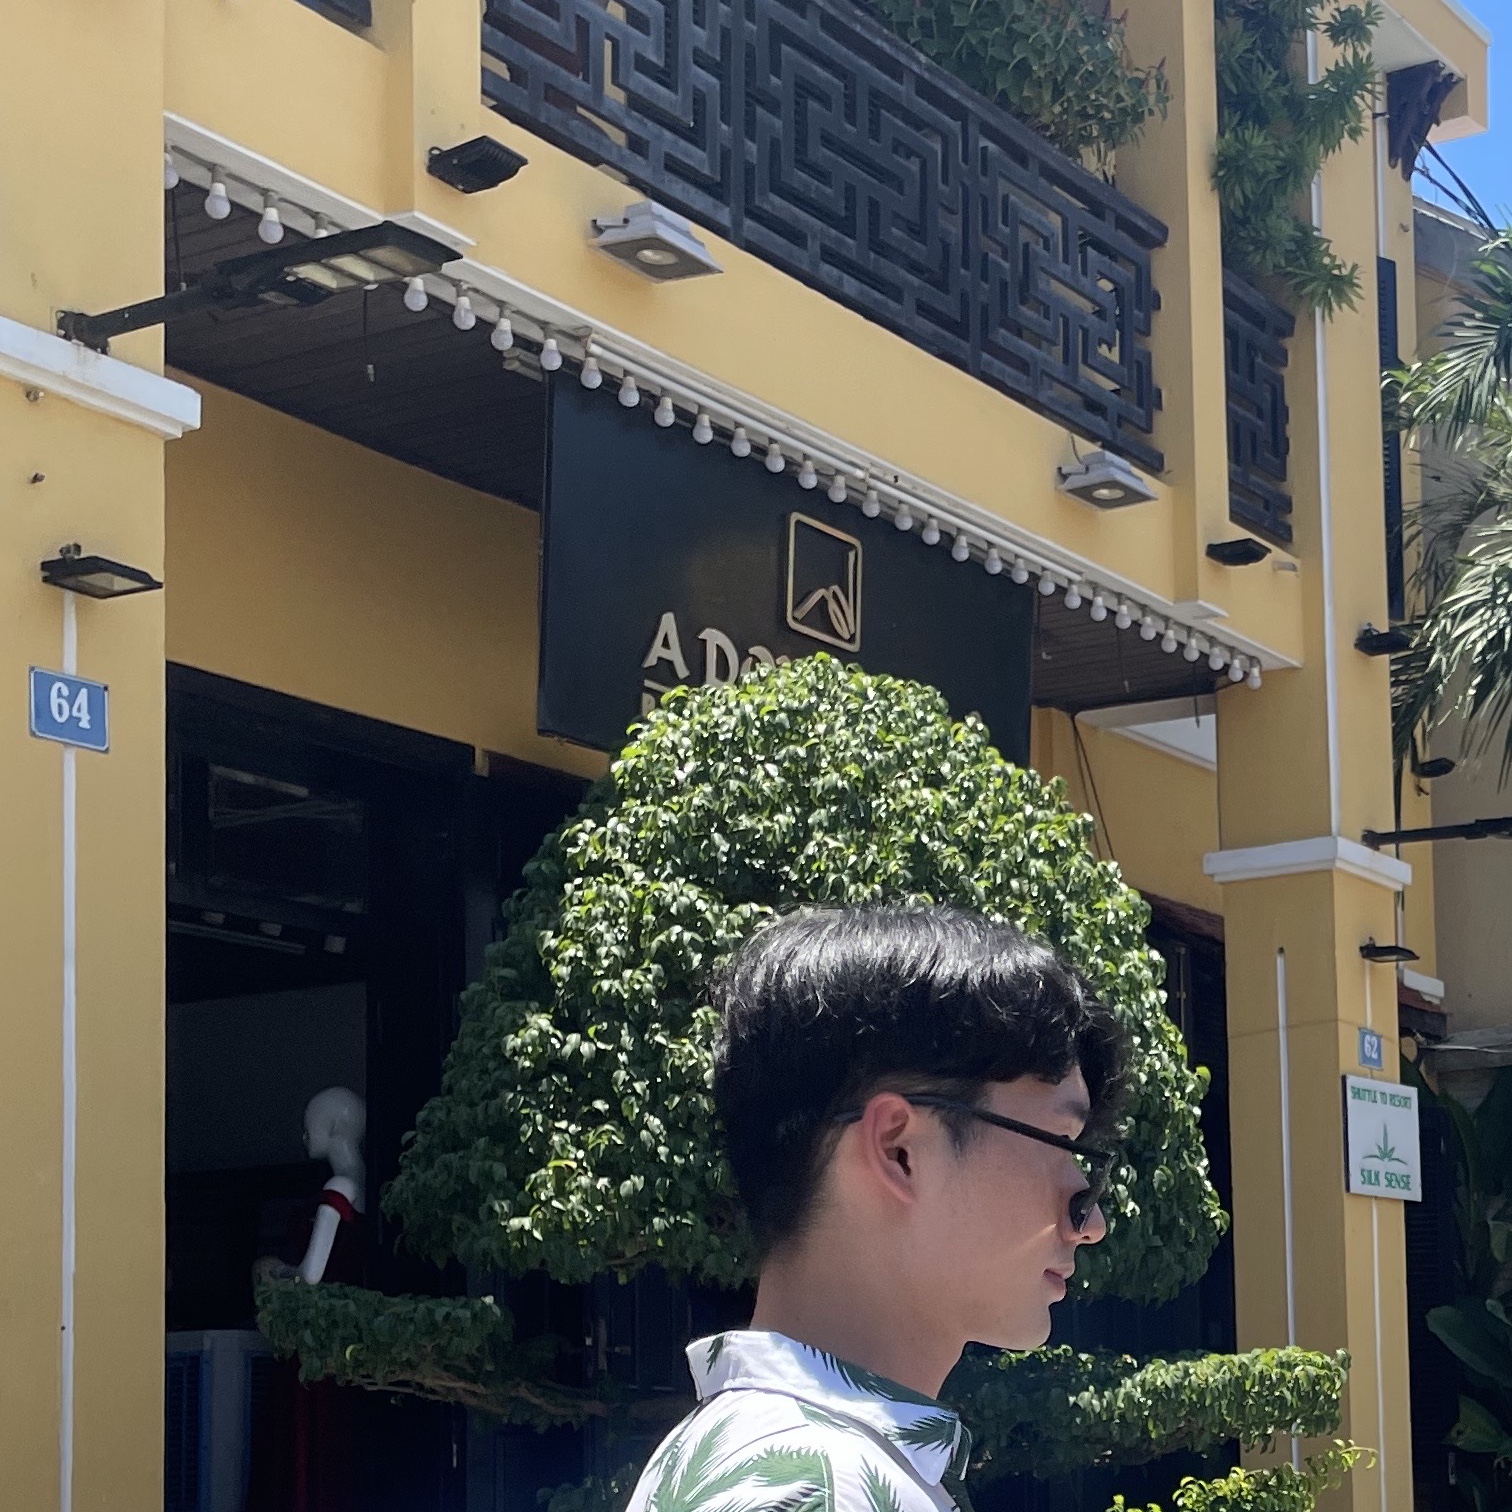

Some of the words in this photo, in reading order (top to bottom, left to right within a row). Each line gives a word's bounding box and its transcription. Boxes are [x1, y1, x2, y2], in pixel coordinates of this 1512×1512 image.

[642, 611, 691, 679] A
[50, 681, 91, 729] 64
[1364, 1034, 1378, 1060] 62
[1350, 1085, 1378, 1103] SHUTTLE
[1379, 1091, 1387, 1105] TO
[1388, 1093, 1412, 1110] RESORT
[1360, 1168, 1380, 1186] SILK
[1384, 1171, 1411, 1191] SENSE
